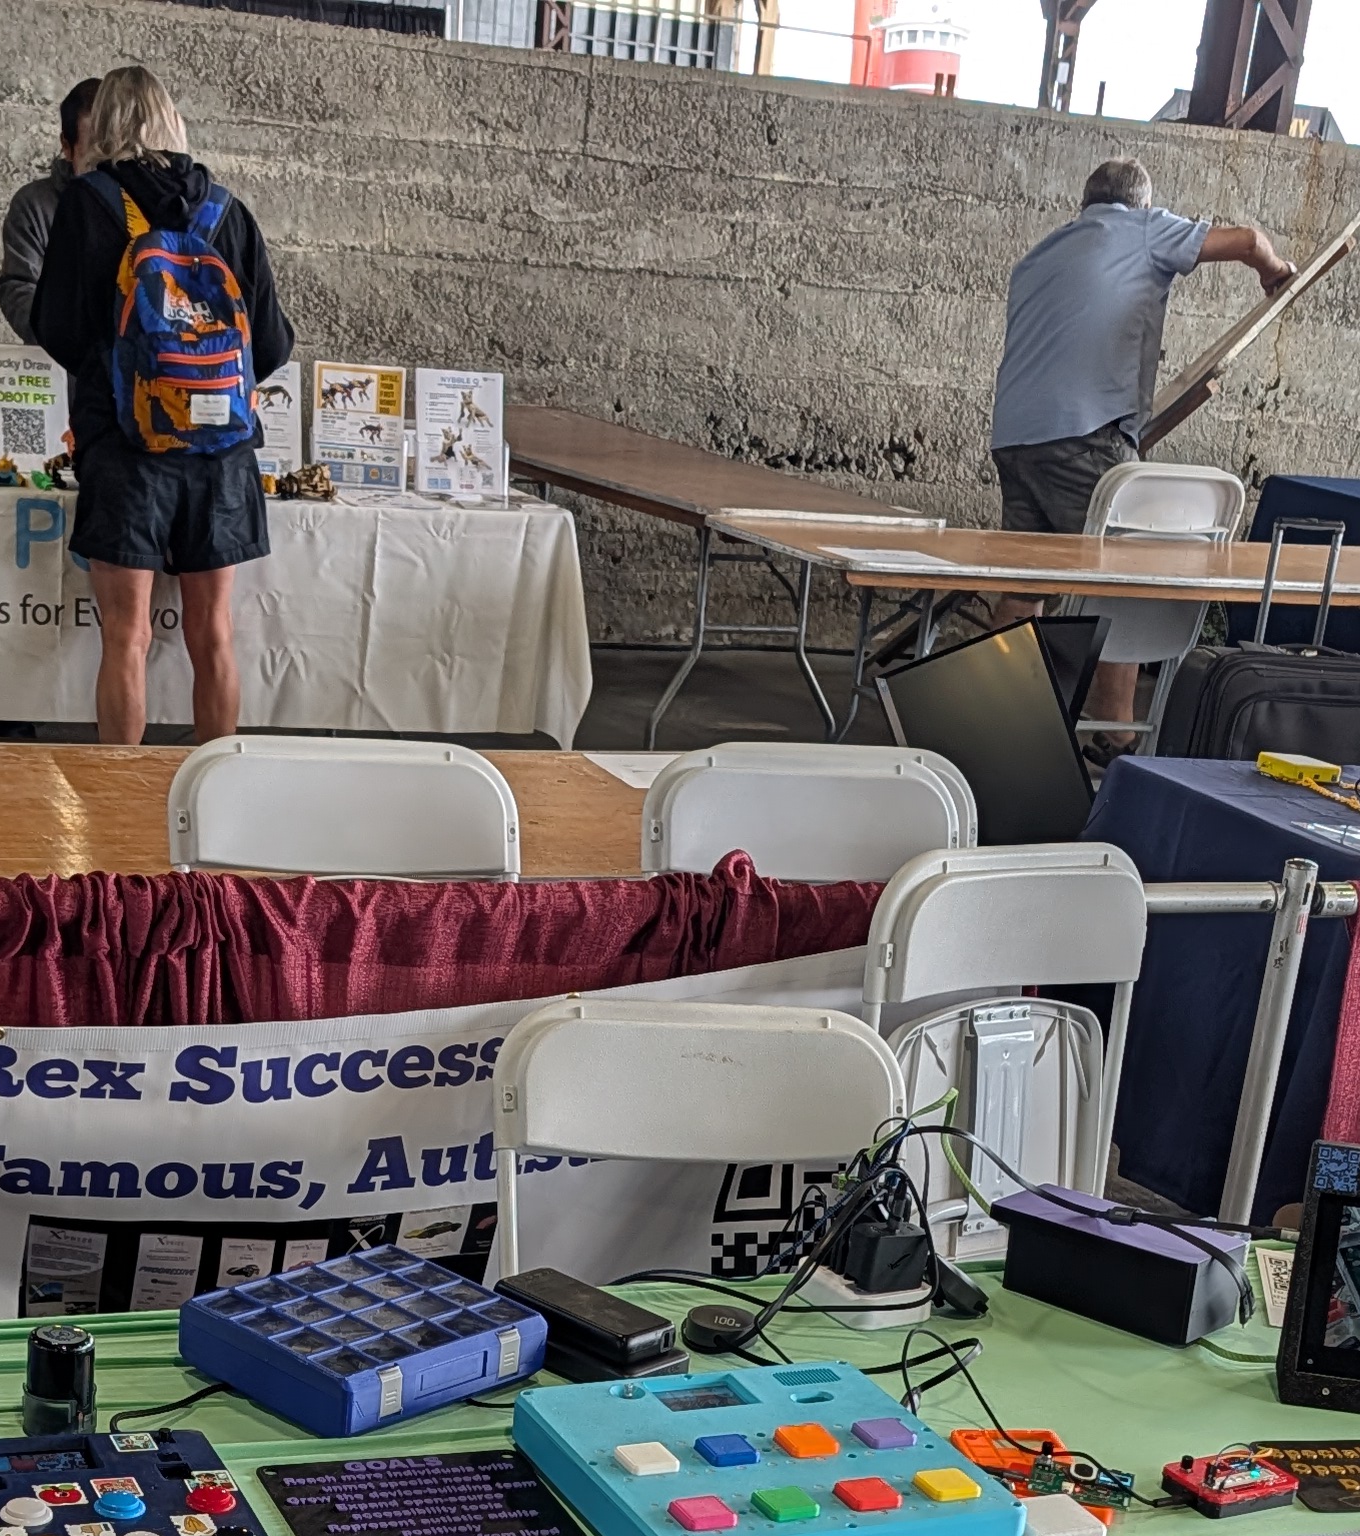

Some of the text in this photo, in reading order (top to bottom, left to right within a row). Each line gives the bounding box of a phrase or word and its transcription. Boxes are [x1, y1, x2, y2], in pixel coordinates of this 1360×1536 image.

[23, 358, 52, 371] Draw
[8, 377, 16, 386] a
[18, 375, 51, 388] FREE
[33, 392, 56, 406] PET
[20, 593, 66, 626] for
[170, 1035, 504, 1106] Success
[343, 1456, 443, 1472] GOALS
[282, 1475, 337, 1487] Reach
[340, 1472, 383, 1481] more
[477, 1461, 514, 1472] with
[321, 1473, 491, 1493] unmet special needs
[286, 1495, 331, 1506] Grow
[335, 1493, 364, 1502] the
[495, 1480, 537, 1489] team
[334, 1499, 399, 1512] Expand
[461, 1502, 503, 1512] tools
[327, 1509, 539, 1533] Represent autistic adults
